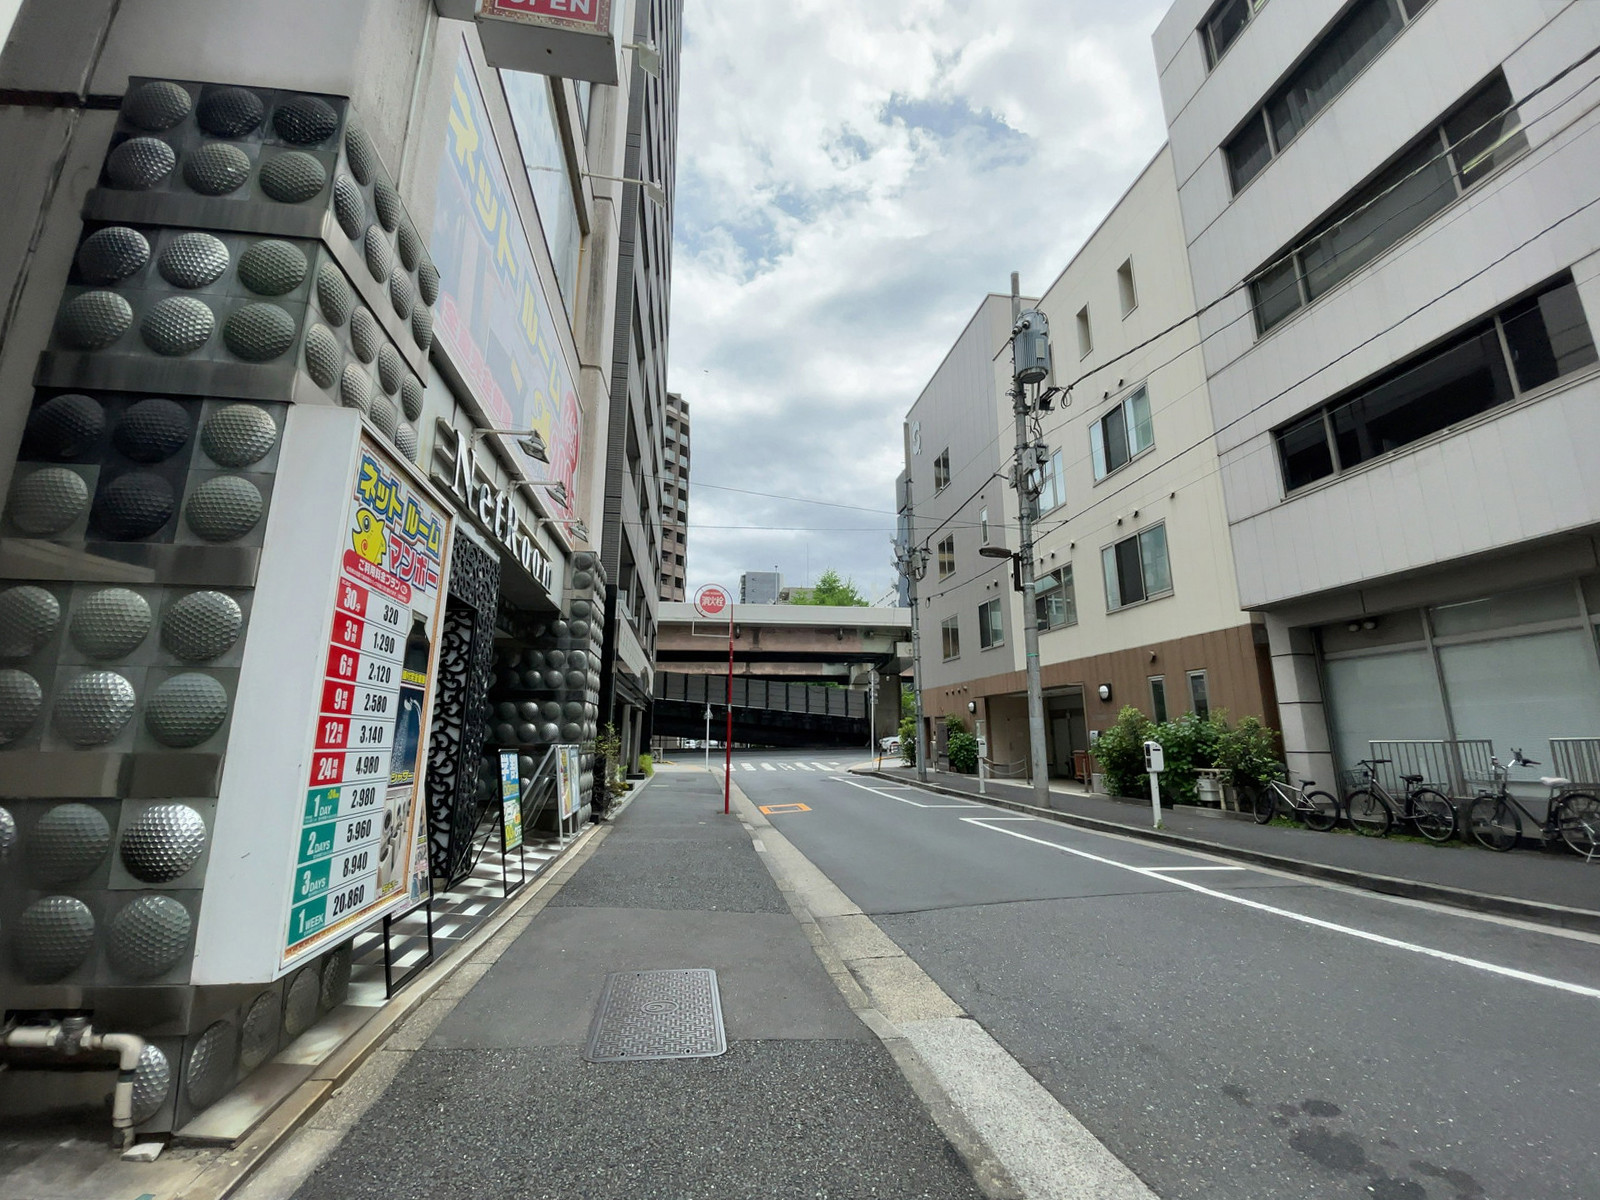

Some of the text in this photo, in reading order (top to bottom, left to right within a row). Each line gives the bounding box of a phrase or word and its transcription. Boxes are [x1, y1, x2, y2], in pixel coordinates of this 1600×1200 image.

[389, 534, 438, 591] マンボー
[702, 596, 724, 607] 消火栓
[384, 605, 398, 625] 320
